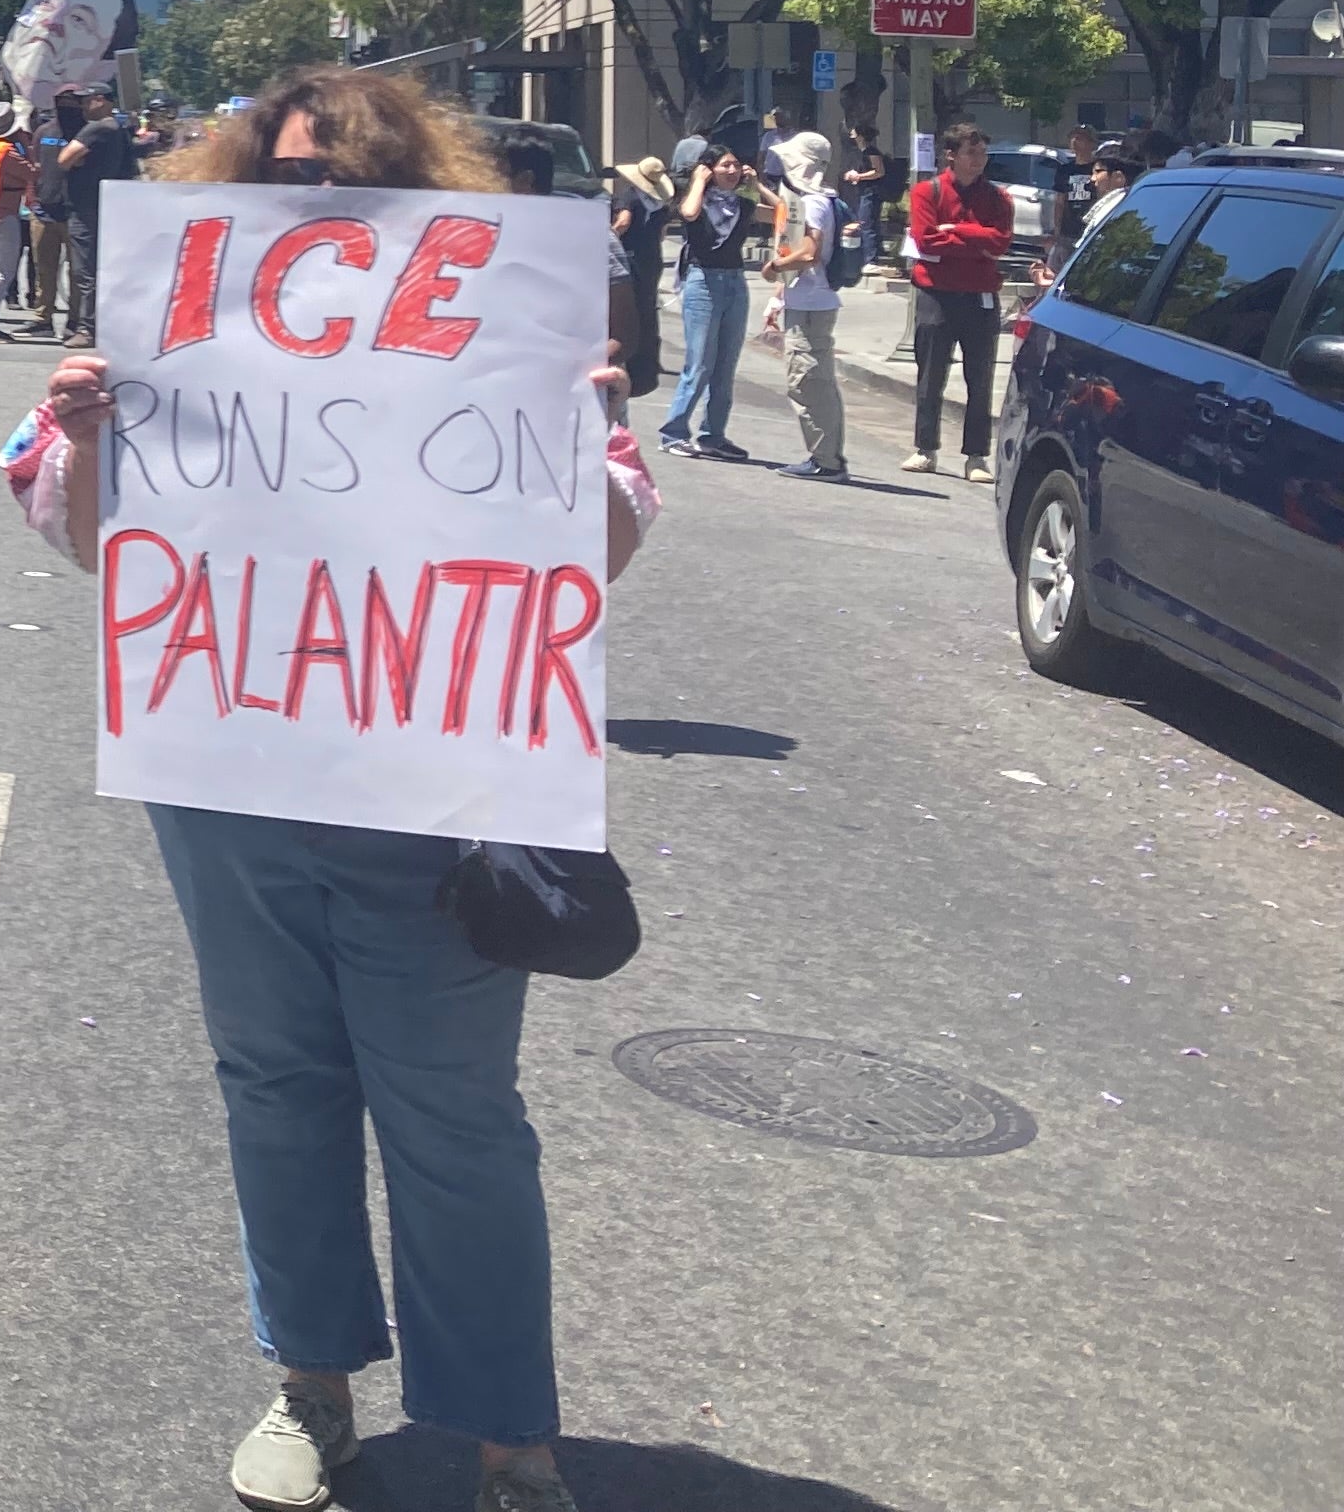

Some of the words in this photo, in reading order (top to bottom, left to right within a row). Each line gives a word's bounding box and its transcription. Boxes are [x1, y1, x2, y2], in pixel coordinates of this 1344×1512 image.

[901, 8, 948, 28] WAY
[153, 214, 502, 360] ICE
[112, 380, 368, 496] RUNS
[419, 403, 582, 512] ON
[104, 528, 603, 759] PALANTIR
